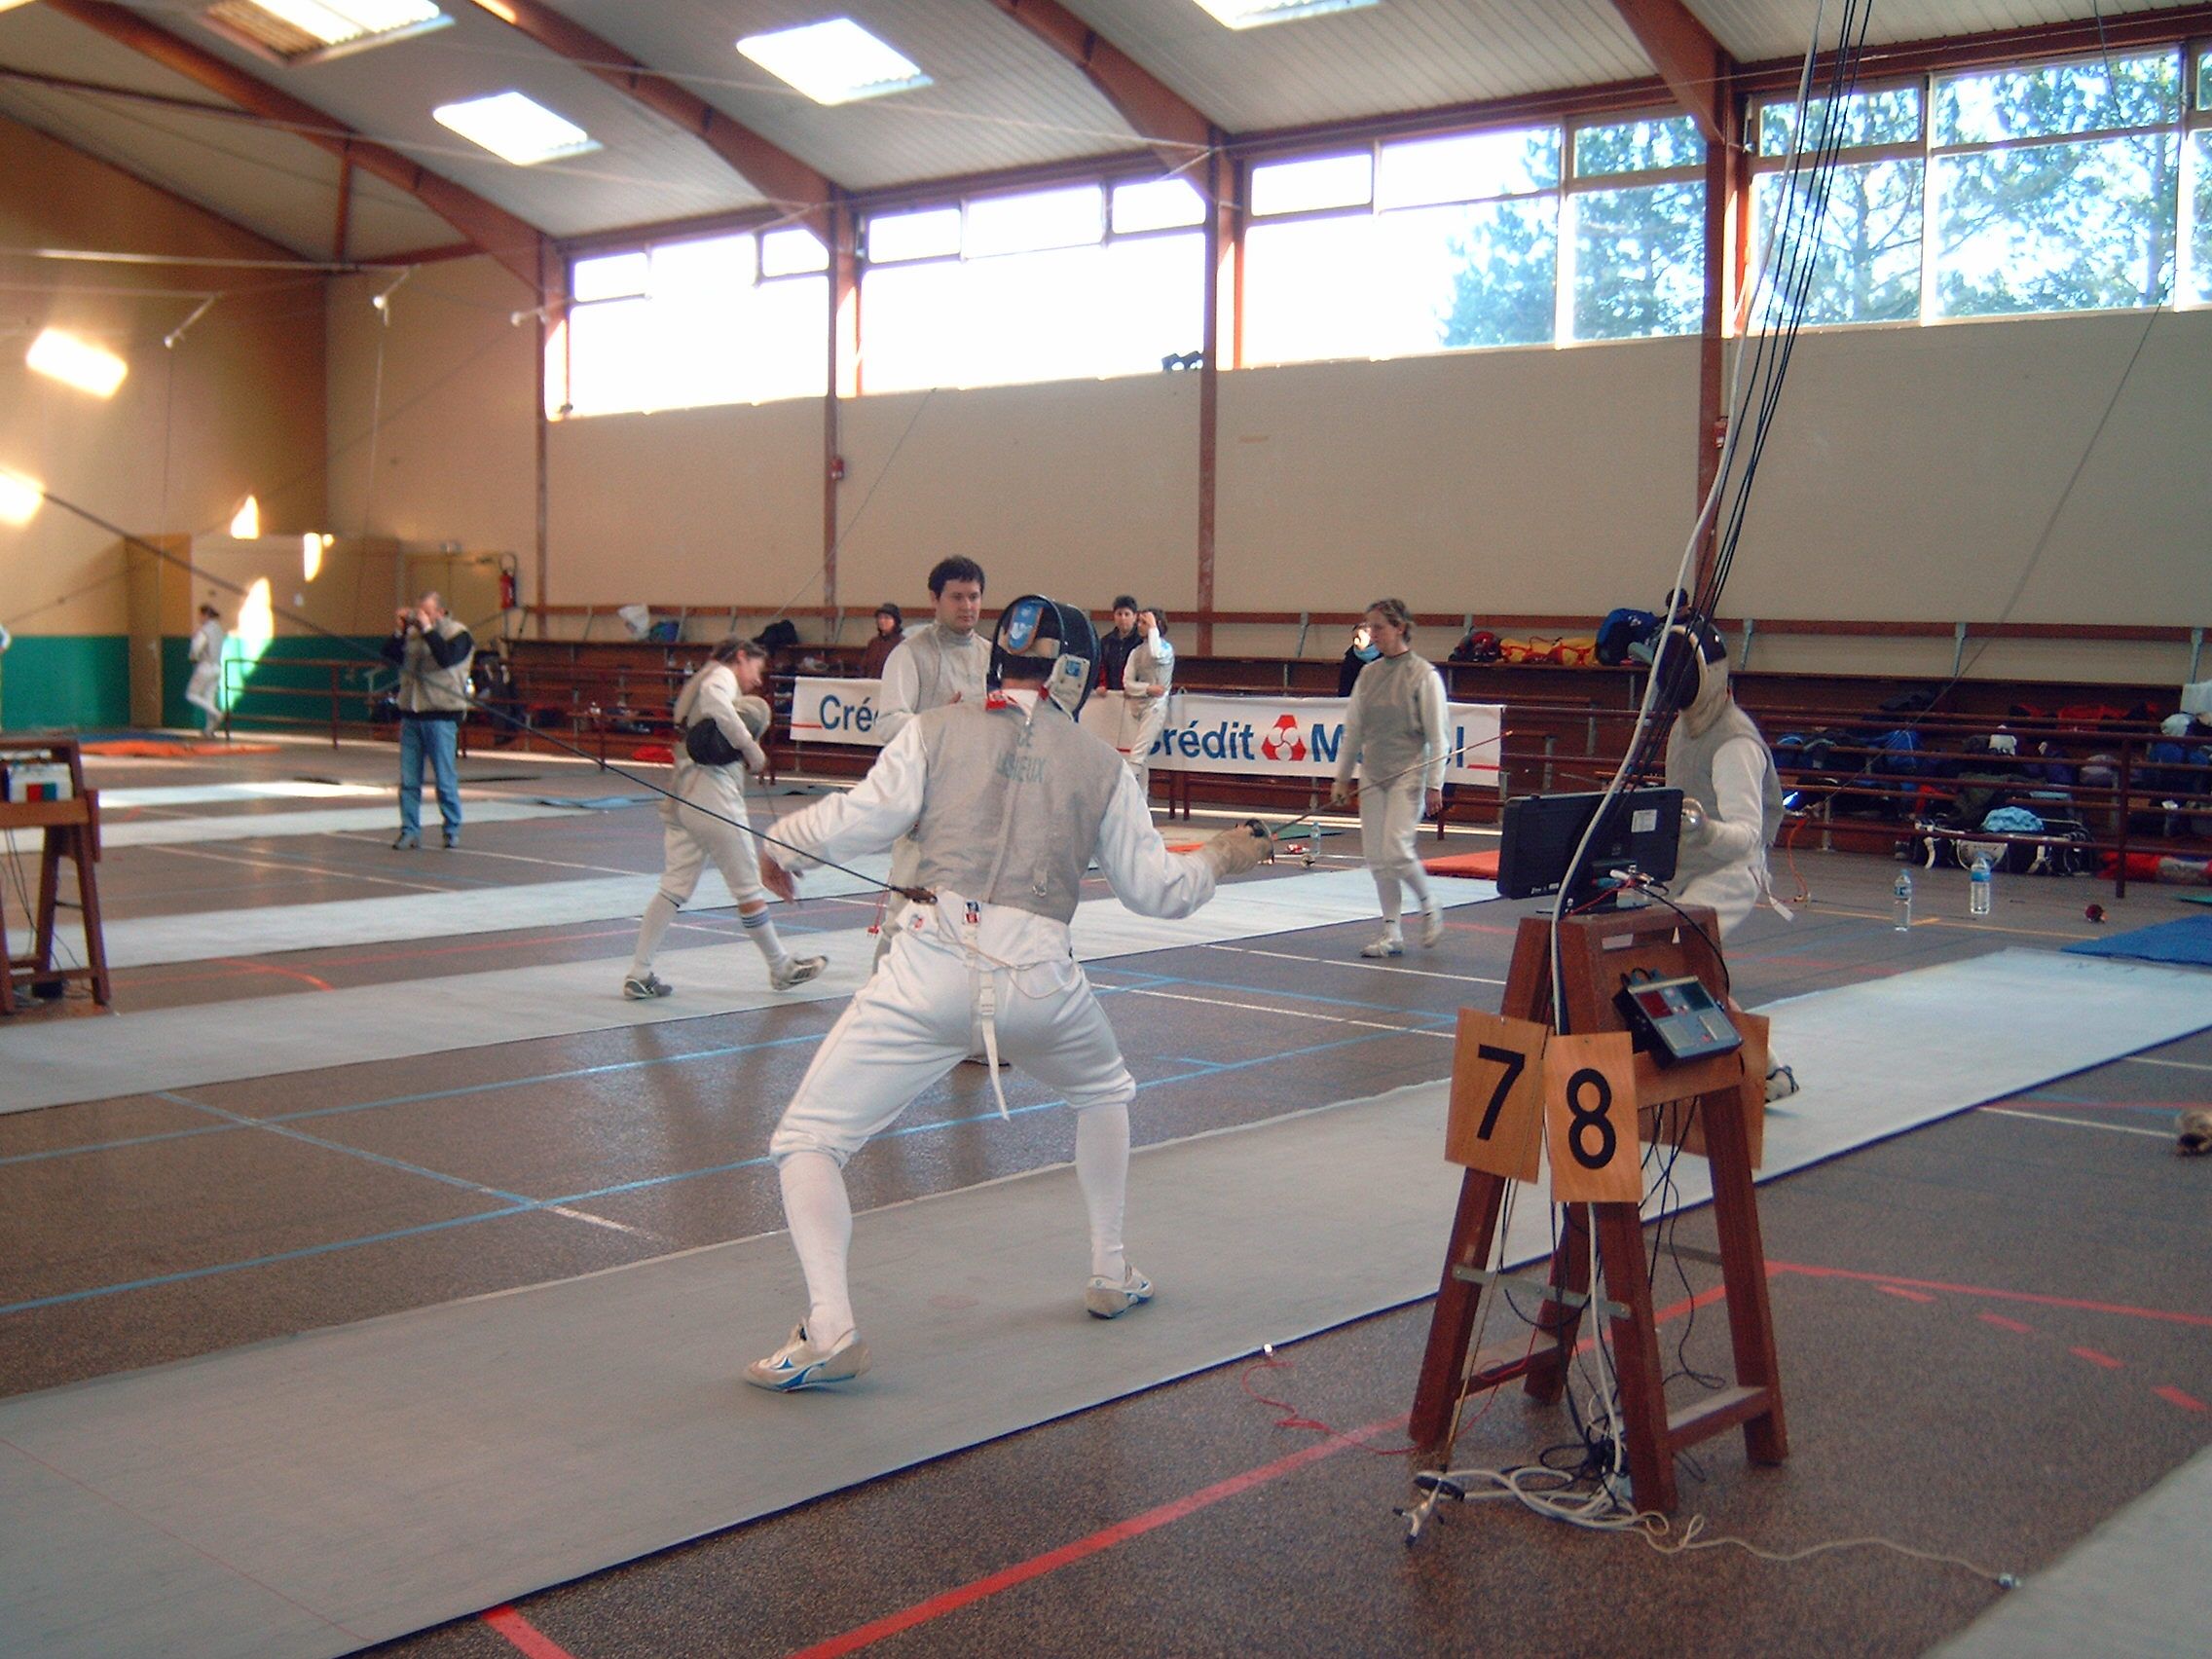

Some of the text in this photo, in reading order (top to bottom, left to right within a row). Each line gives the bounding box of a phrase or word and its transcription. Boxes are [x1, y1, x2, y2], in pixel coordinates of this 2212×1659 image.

[820, 694, 879, 732] Cré
[1477, 1044, 1526, 1140] 7
[1566, 1068, 1617, 1169] 8
